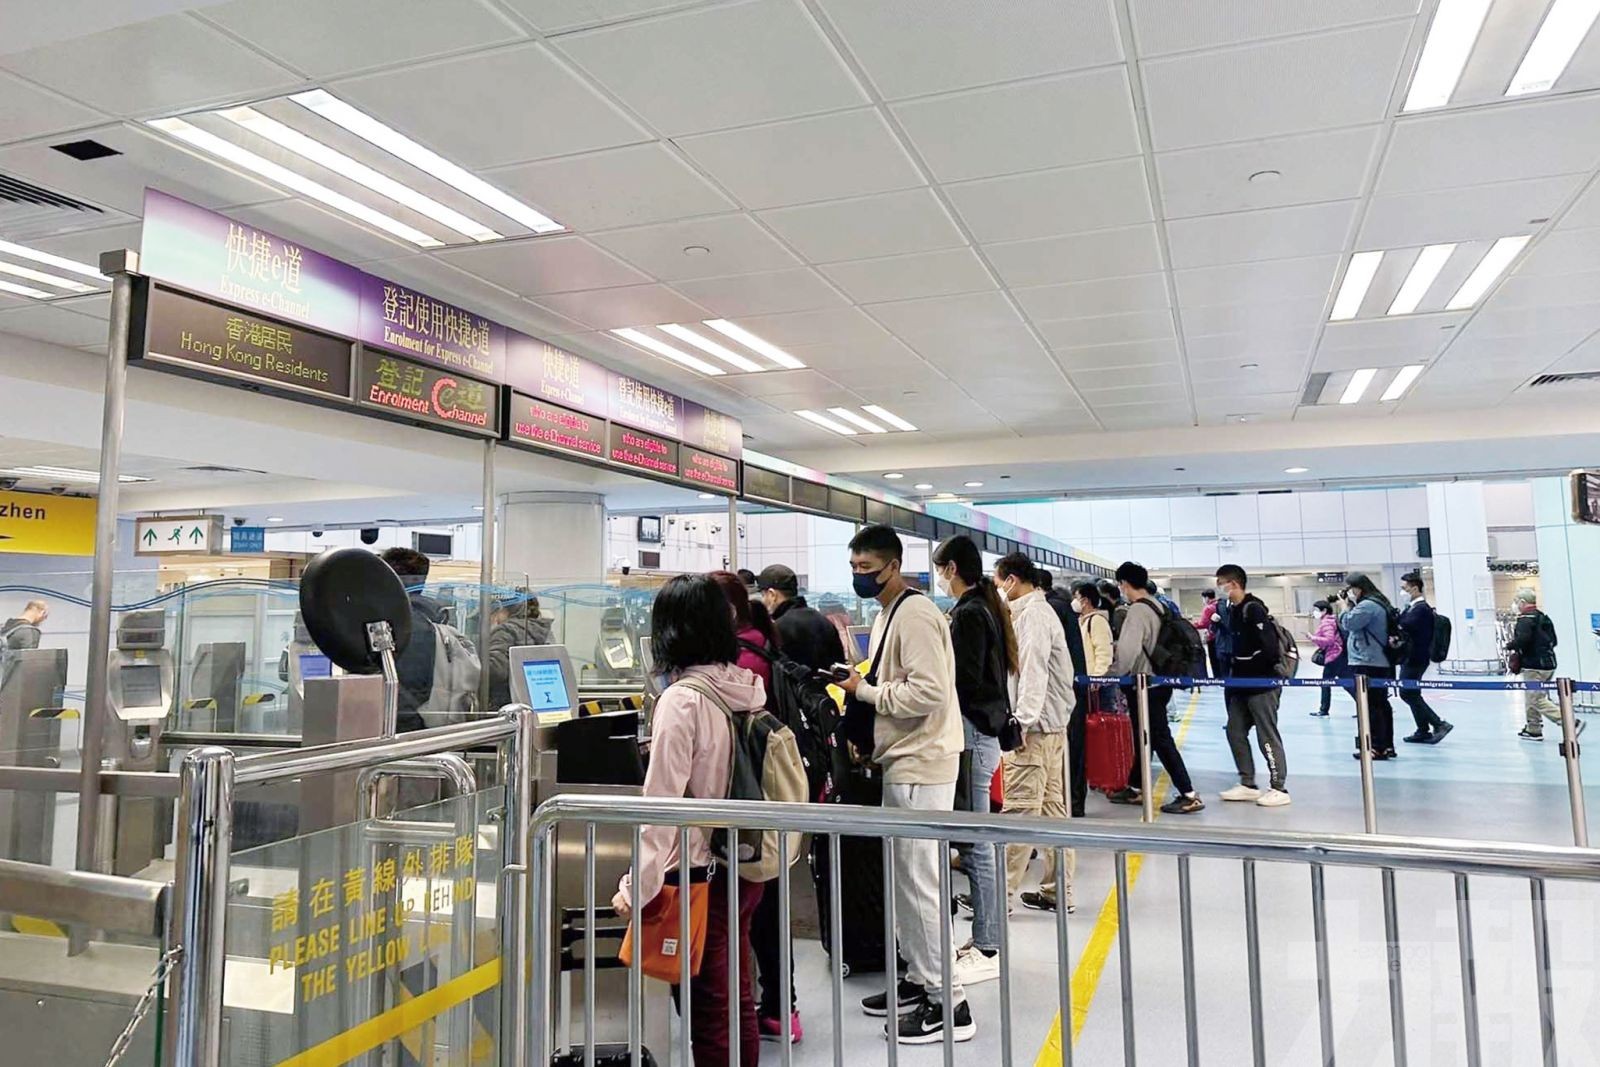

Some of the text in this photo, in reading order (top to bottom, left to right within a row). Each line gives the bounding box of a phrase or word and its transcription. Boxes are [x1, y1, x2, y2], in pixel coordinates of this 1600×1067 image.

[225, 222, 303, 294] 快捷e道
[220, 274, 310, 320] Express e-Channel
[382, 284, 490, 356] 登記使用快捷e道
[181, 331, 329, 382] Hong Kong Residents
[226, 317, 292, 355] 香港居民
[384, 326, 494, 374] Enrolment for Express e-Channel
[370, 385, 429, 414] Enrolment
[376, 359, 426, 397] 登記
[268, 923, 341, 976] PLEASE
[349, 906, 387, 946] LINE
[301, 963, 338, 1004] THE
[345, 935, 411, 984] YELLOW
